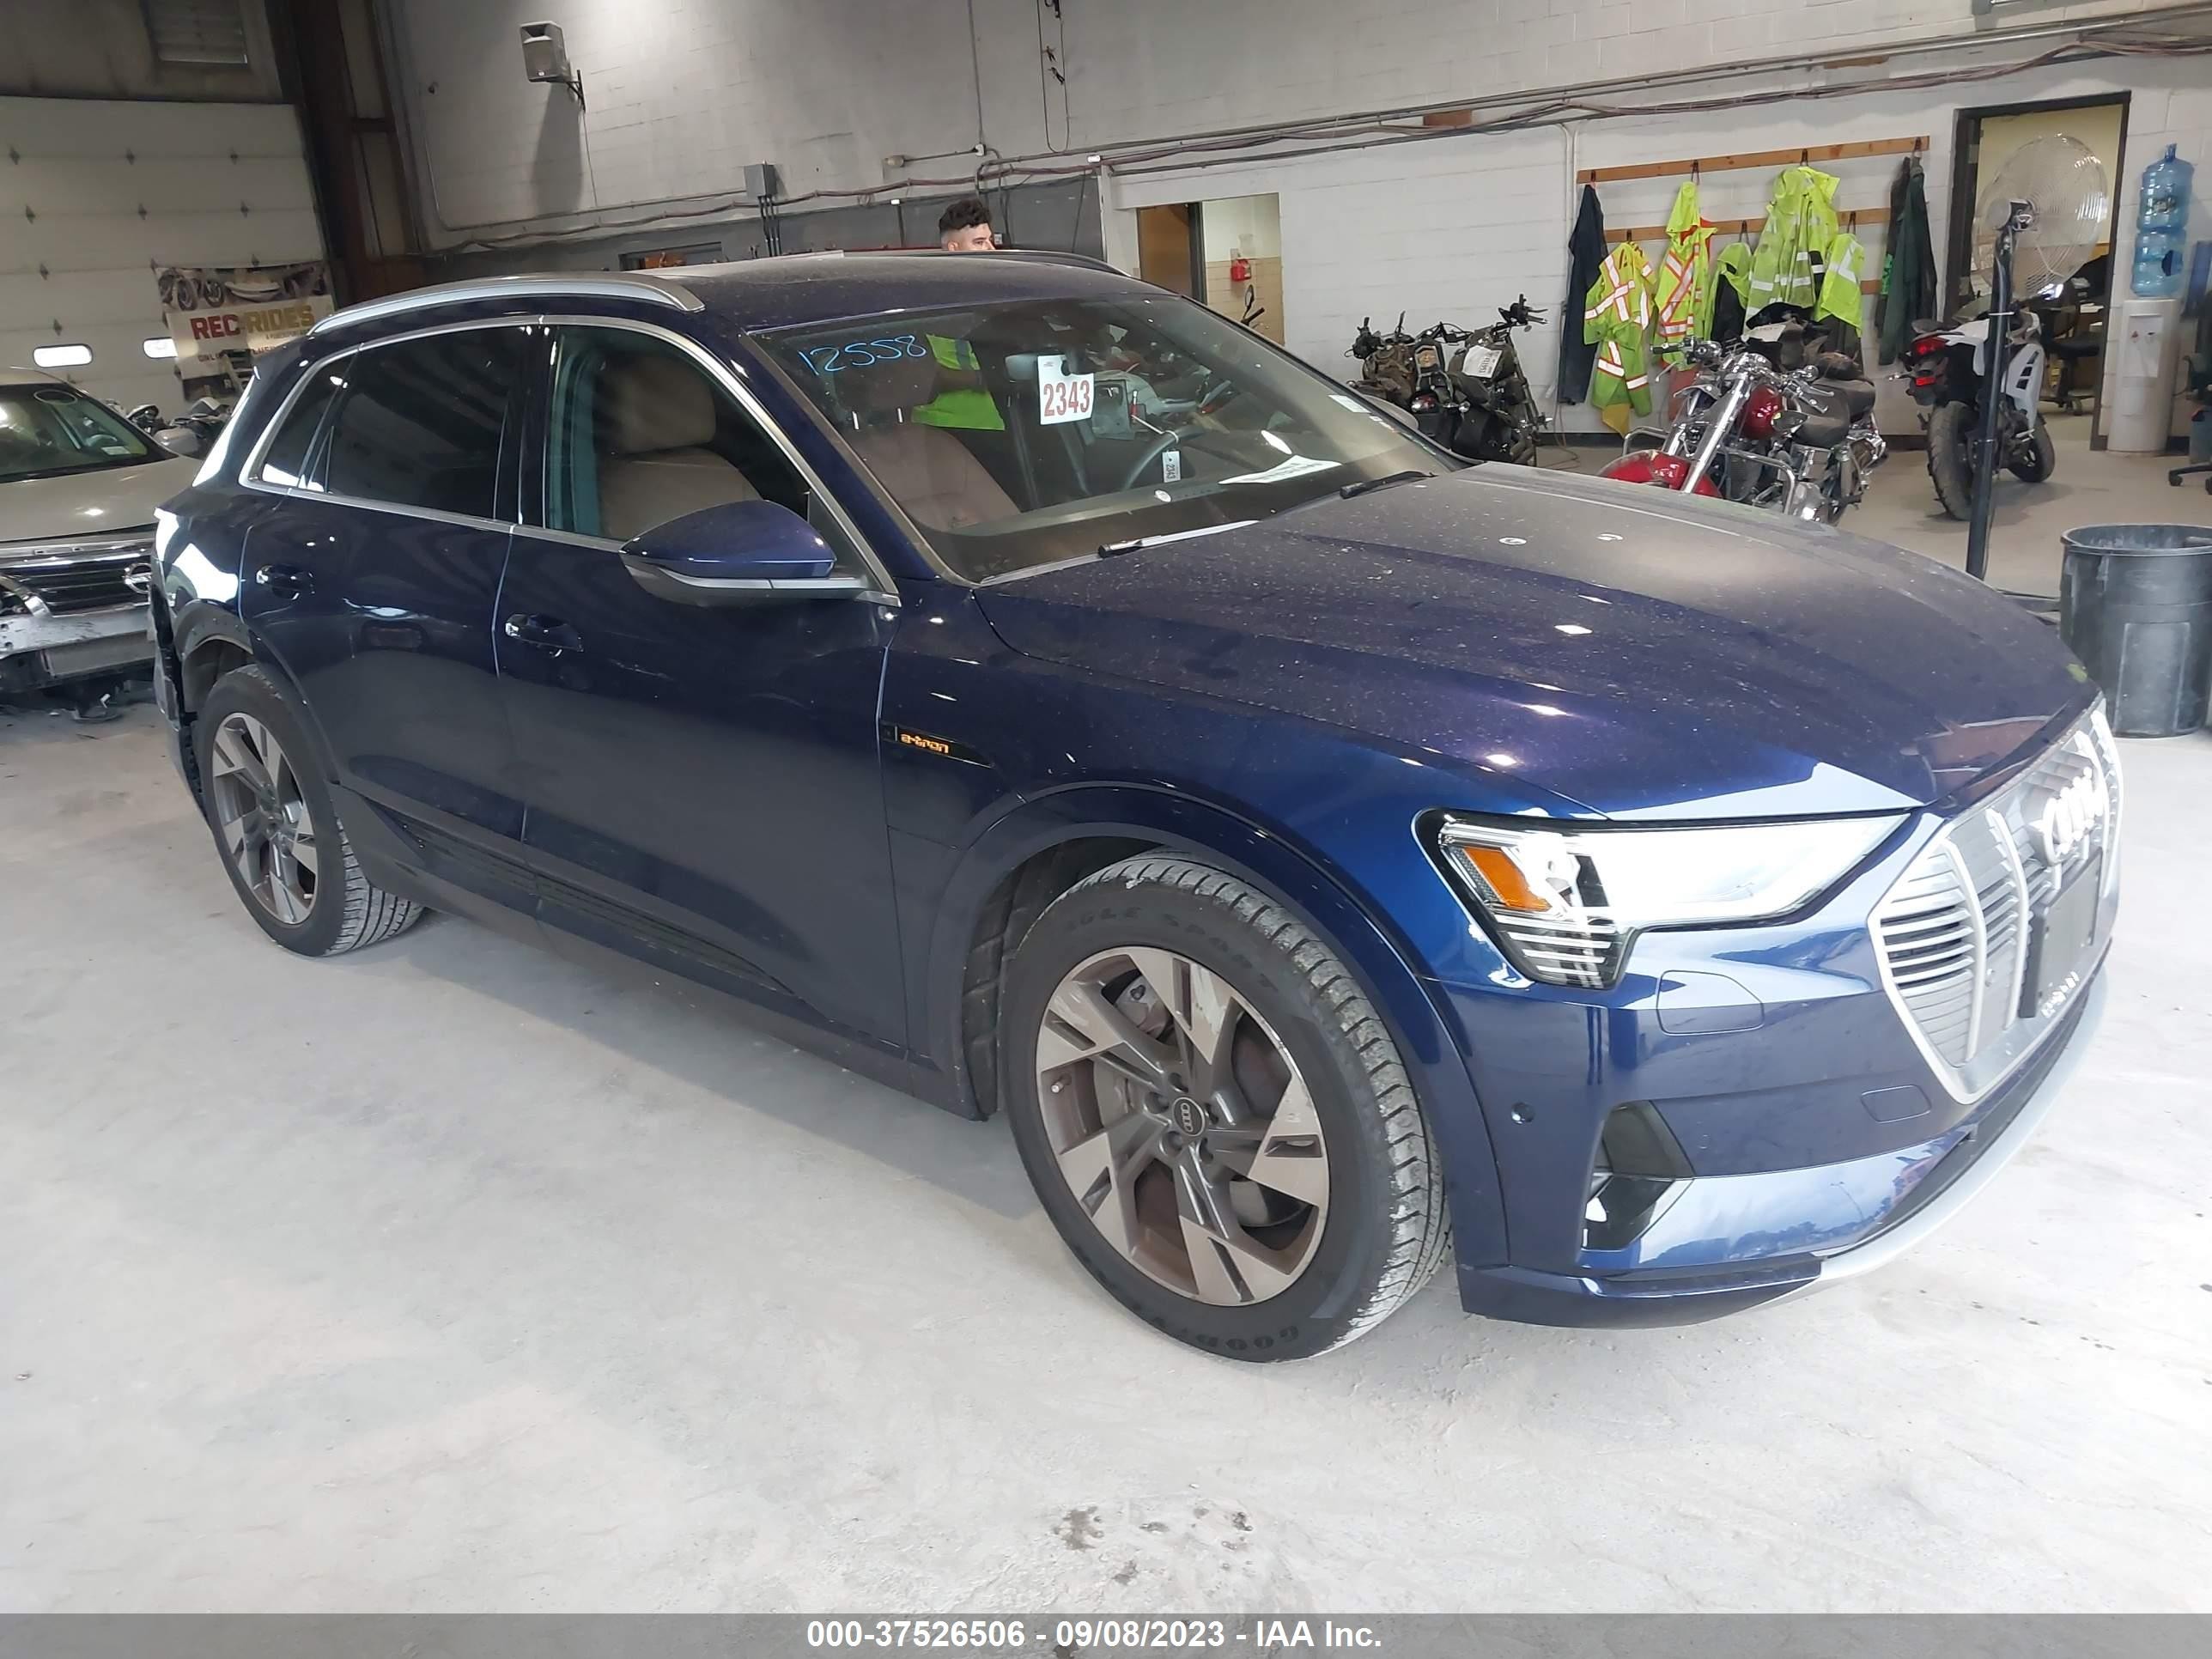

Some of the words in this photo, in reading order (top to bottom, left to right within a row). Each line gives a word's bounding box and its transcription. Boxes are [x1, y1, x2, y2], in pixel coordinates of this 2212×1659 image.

[190, 313, 241, 341] REC
[244, 304, 316, 334] RIDES
[798, 334, 927, 376] 12558
[1043, 380, 1091, 417] 2343
[900, 733, 950, 754] e-tron
